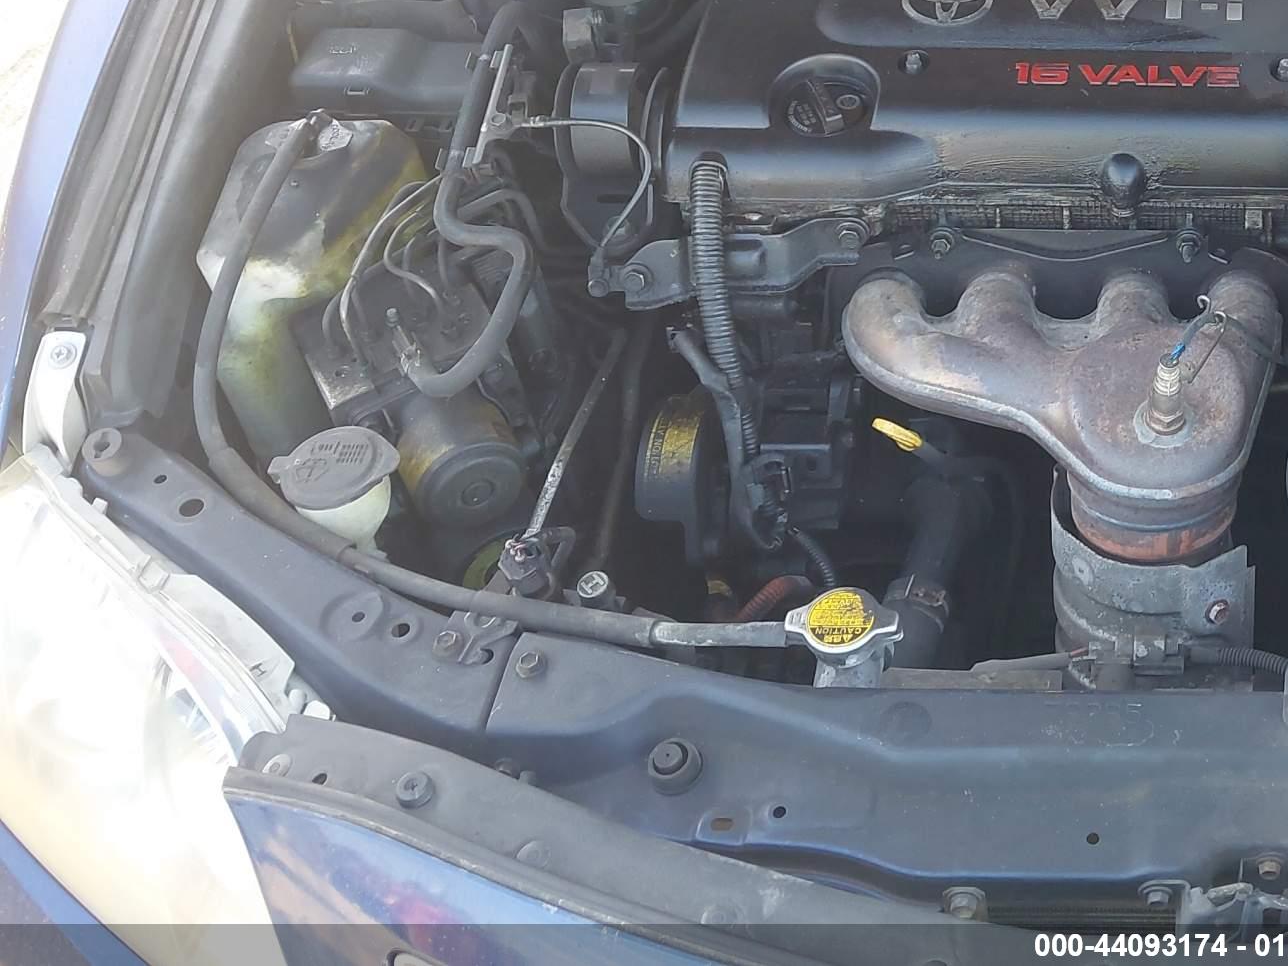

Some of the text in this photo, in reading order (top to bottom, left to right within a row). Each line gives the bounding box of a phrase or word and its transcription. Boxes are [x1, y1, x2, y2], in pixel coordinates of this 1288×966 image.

[1016, 62, 1241, 88] 16 VALVE
[815, 626, 862, 635] CAUTION
